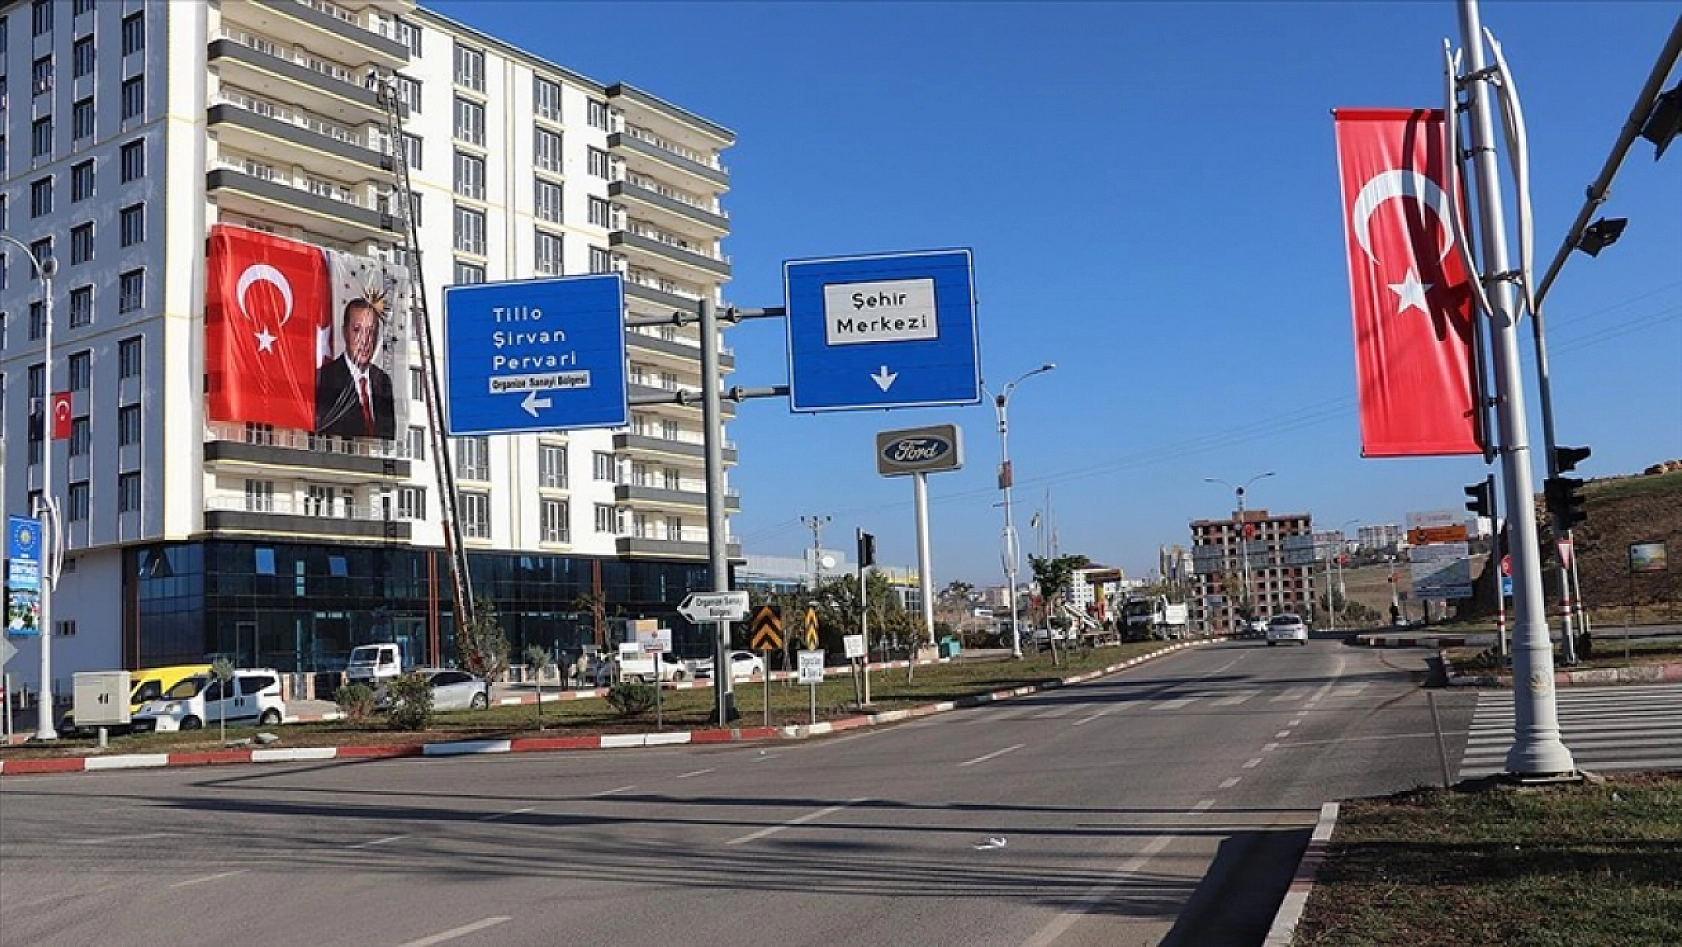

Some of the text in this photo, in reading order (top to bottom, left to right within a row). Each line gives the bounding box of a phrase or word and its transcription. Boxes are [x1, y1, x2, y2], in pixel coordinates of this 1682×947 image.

[851, 291, 906, 310] Şehir
[492, 307, 542, 322] Tillo
[836, 313, 928, 334] Merkezi
[492, 330, 566, 349] Şirvan
[492, 350, 577, 370] Pervari
[894, 440, 938, 461] Ford
